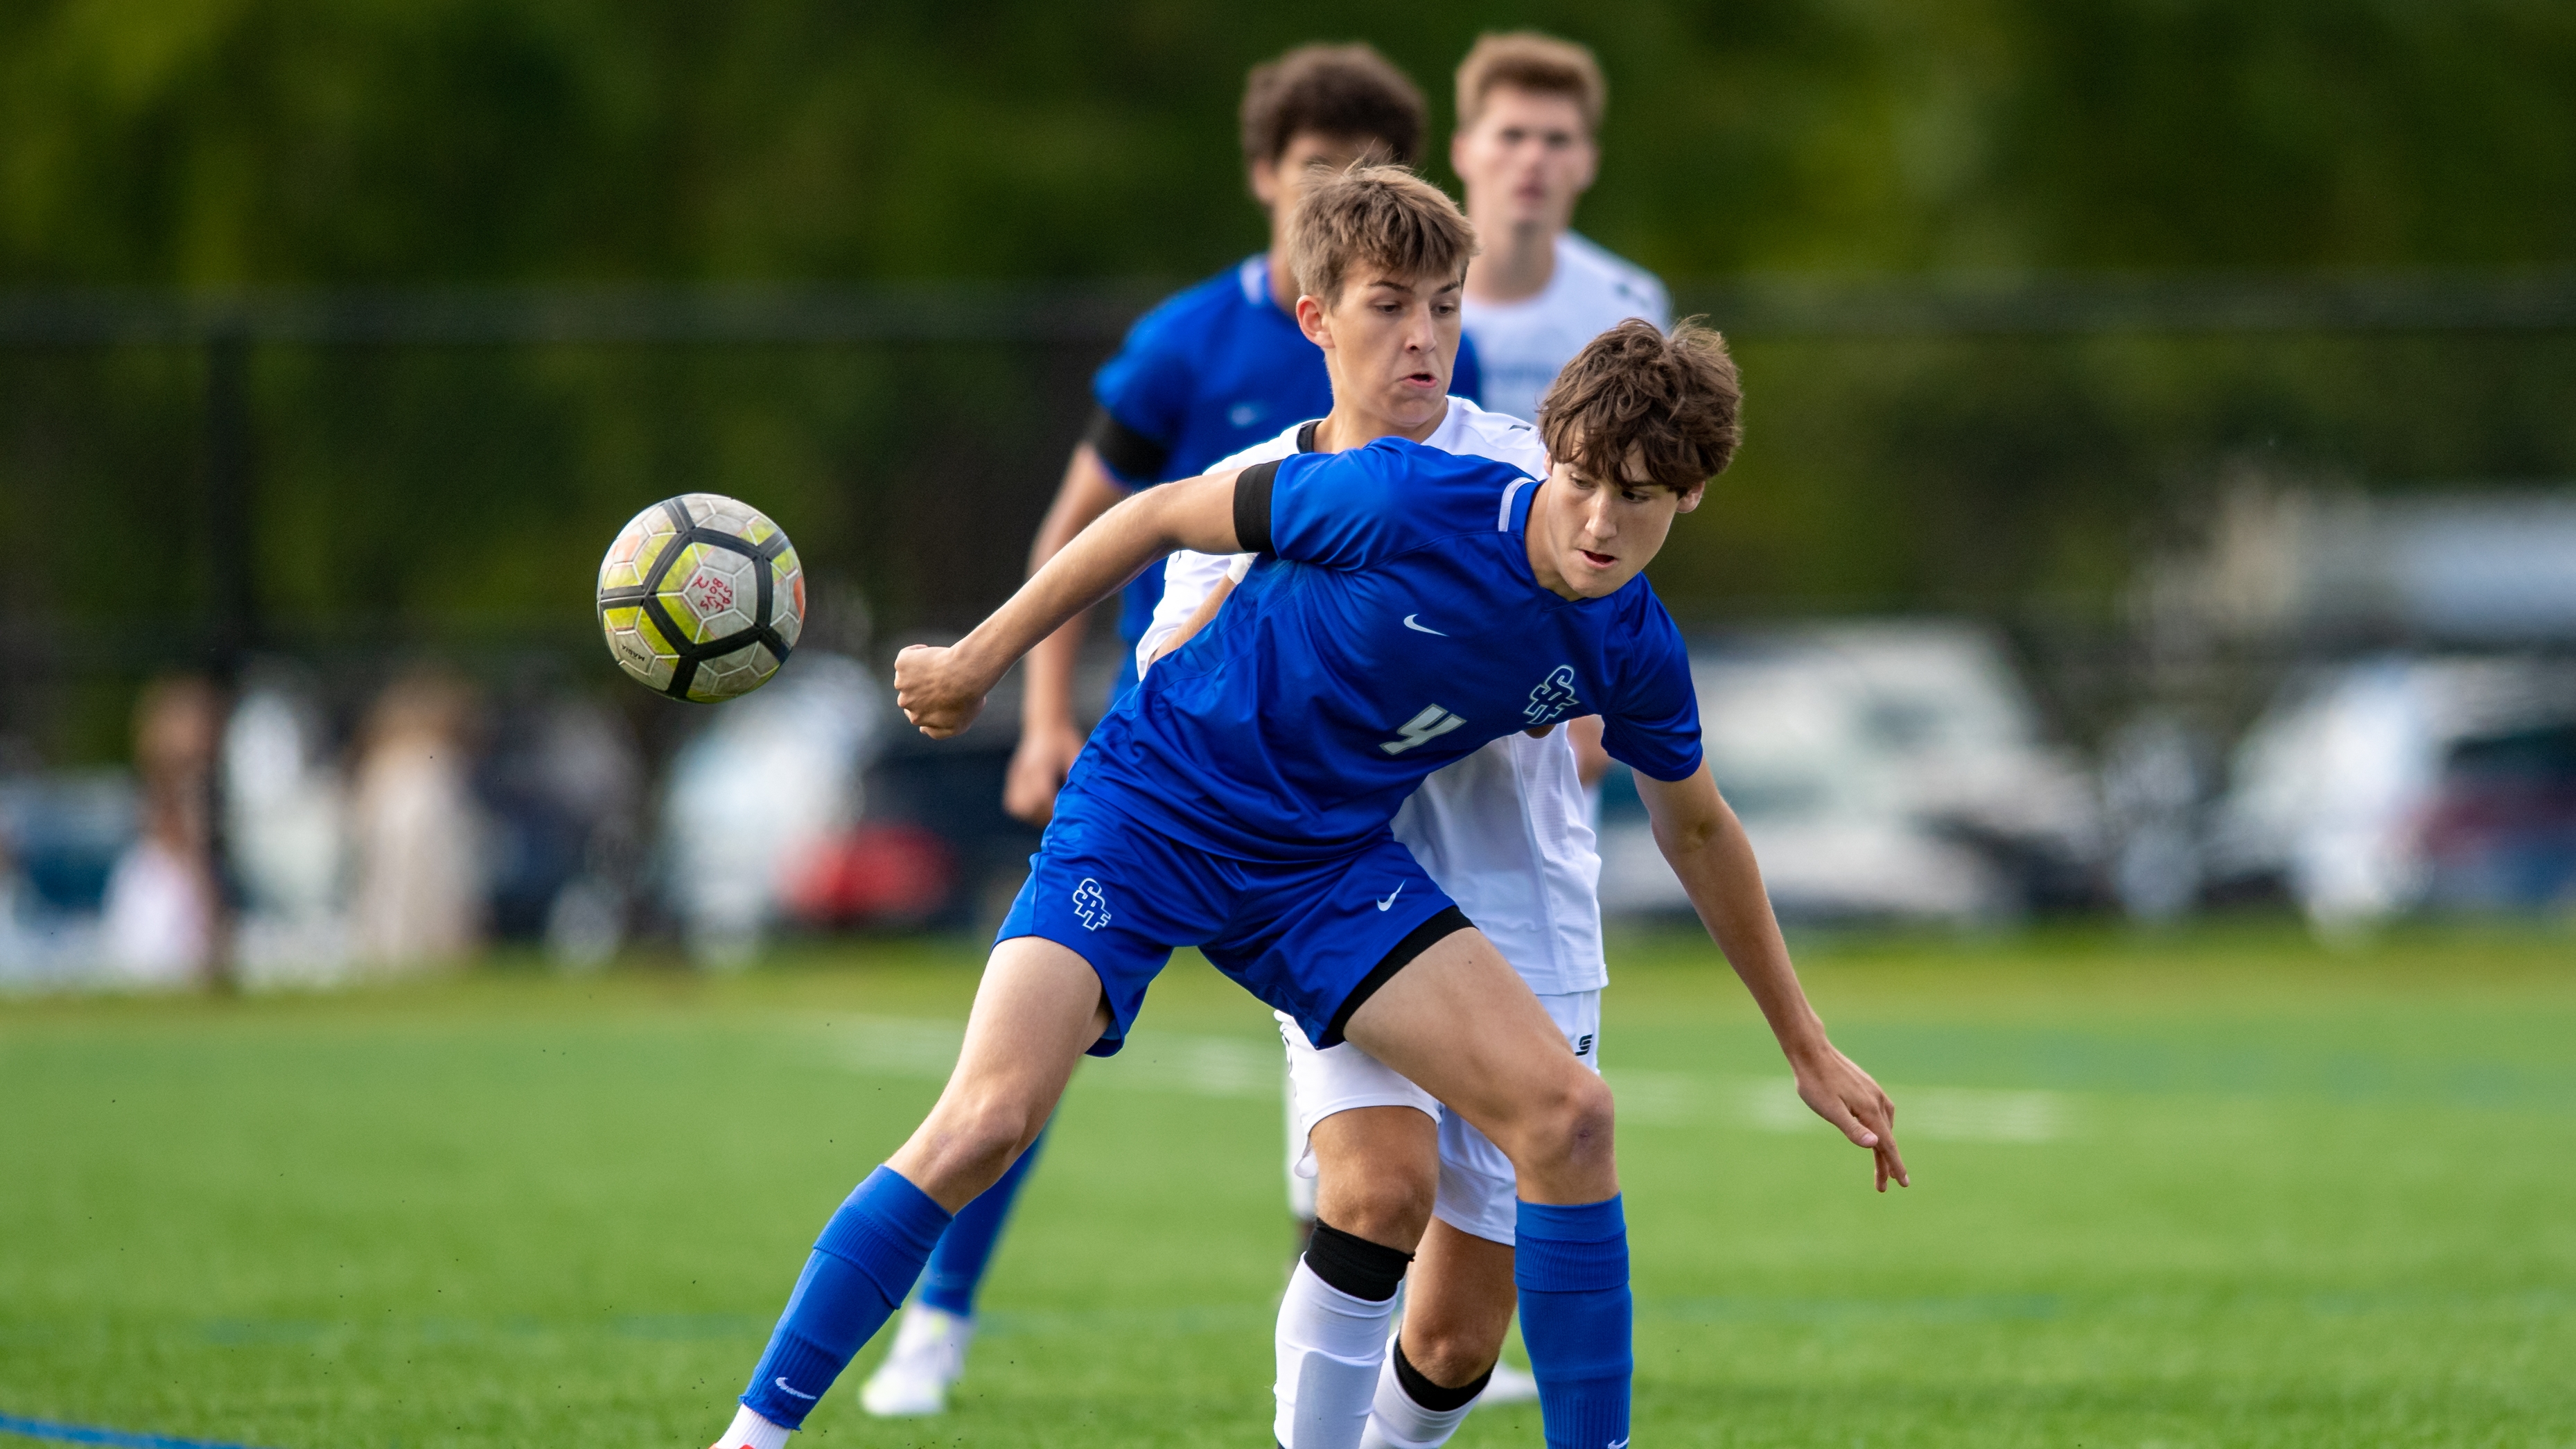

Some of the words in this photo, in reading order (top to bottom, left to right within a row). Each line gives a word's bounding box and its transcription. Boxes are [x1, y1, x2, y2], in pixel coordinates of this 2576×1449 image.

[691, 574, 710, 589] 2
[699, 577, 724, 611] BOYS
[714, 586, 733, 613] SPF
[1378, 703, 1467, 755] 4
[1071, 877, 1112, 932] SPF
